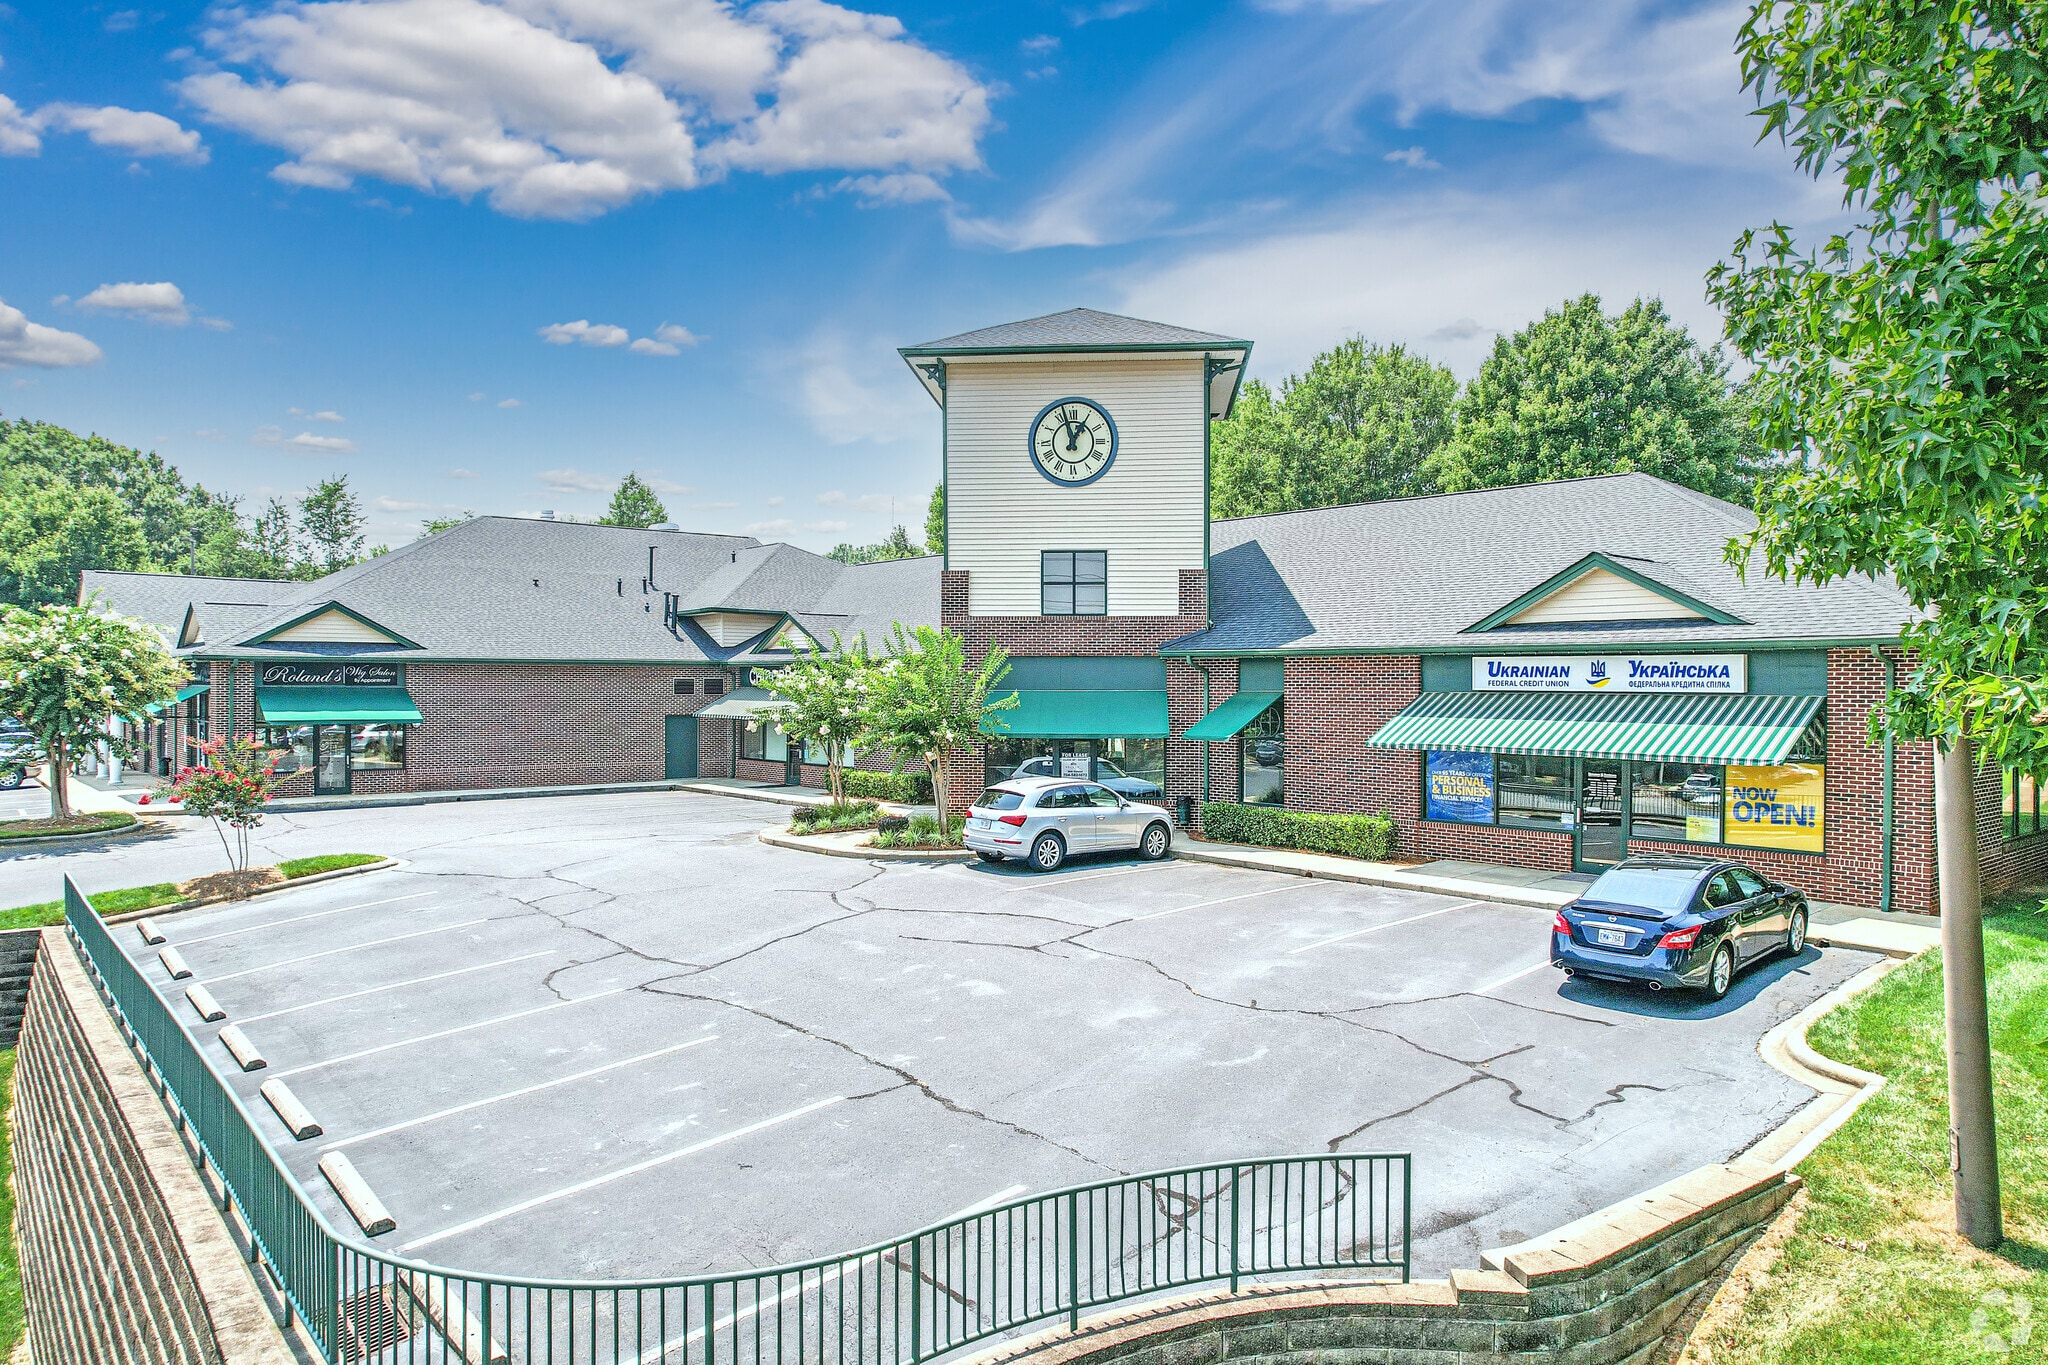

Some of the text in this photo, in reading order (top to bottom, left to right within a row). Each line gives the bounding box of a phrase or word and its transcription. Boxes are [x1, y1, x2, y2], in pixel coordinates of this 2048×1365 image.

[263, 665, 342, 683] Roland's
[345, 665, 396, 677] Wig Salon
[1487, 661, 1571, 678] UKRAINIAN
[1671, 681, 1704, 689] КРЕДИТНА
[1432, 775, 1486, 787] PERSONAL
[1432, 785, 1491, 797] & BUSINESS
[1733, 786, 1778, 802] NOW
[1733, 801, 1816, 828] OPEN!
